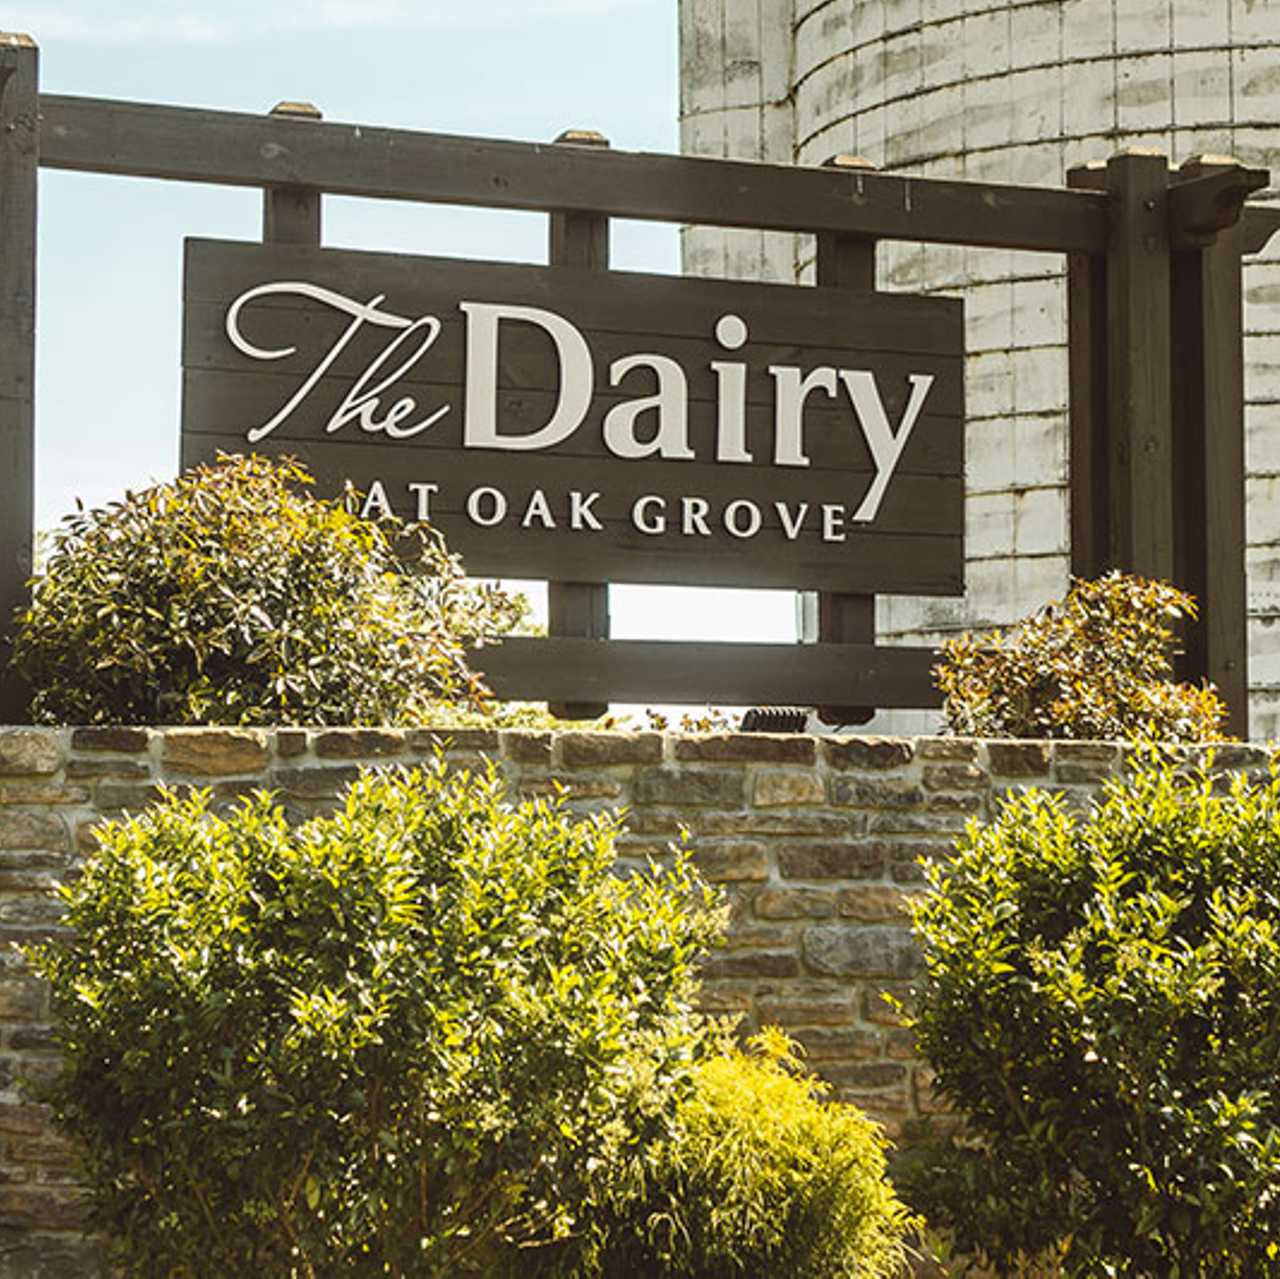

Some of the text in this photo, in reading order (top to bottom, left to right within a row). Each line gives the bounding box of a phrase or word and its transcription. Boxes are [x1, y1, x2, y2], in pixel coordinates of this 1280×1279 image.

[224, 281, 935, 523] The Dairy
[359, 480, 848, 543] AT OAK GROVE
